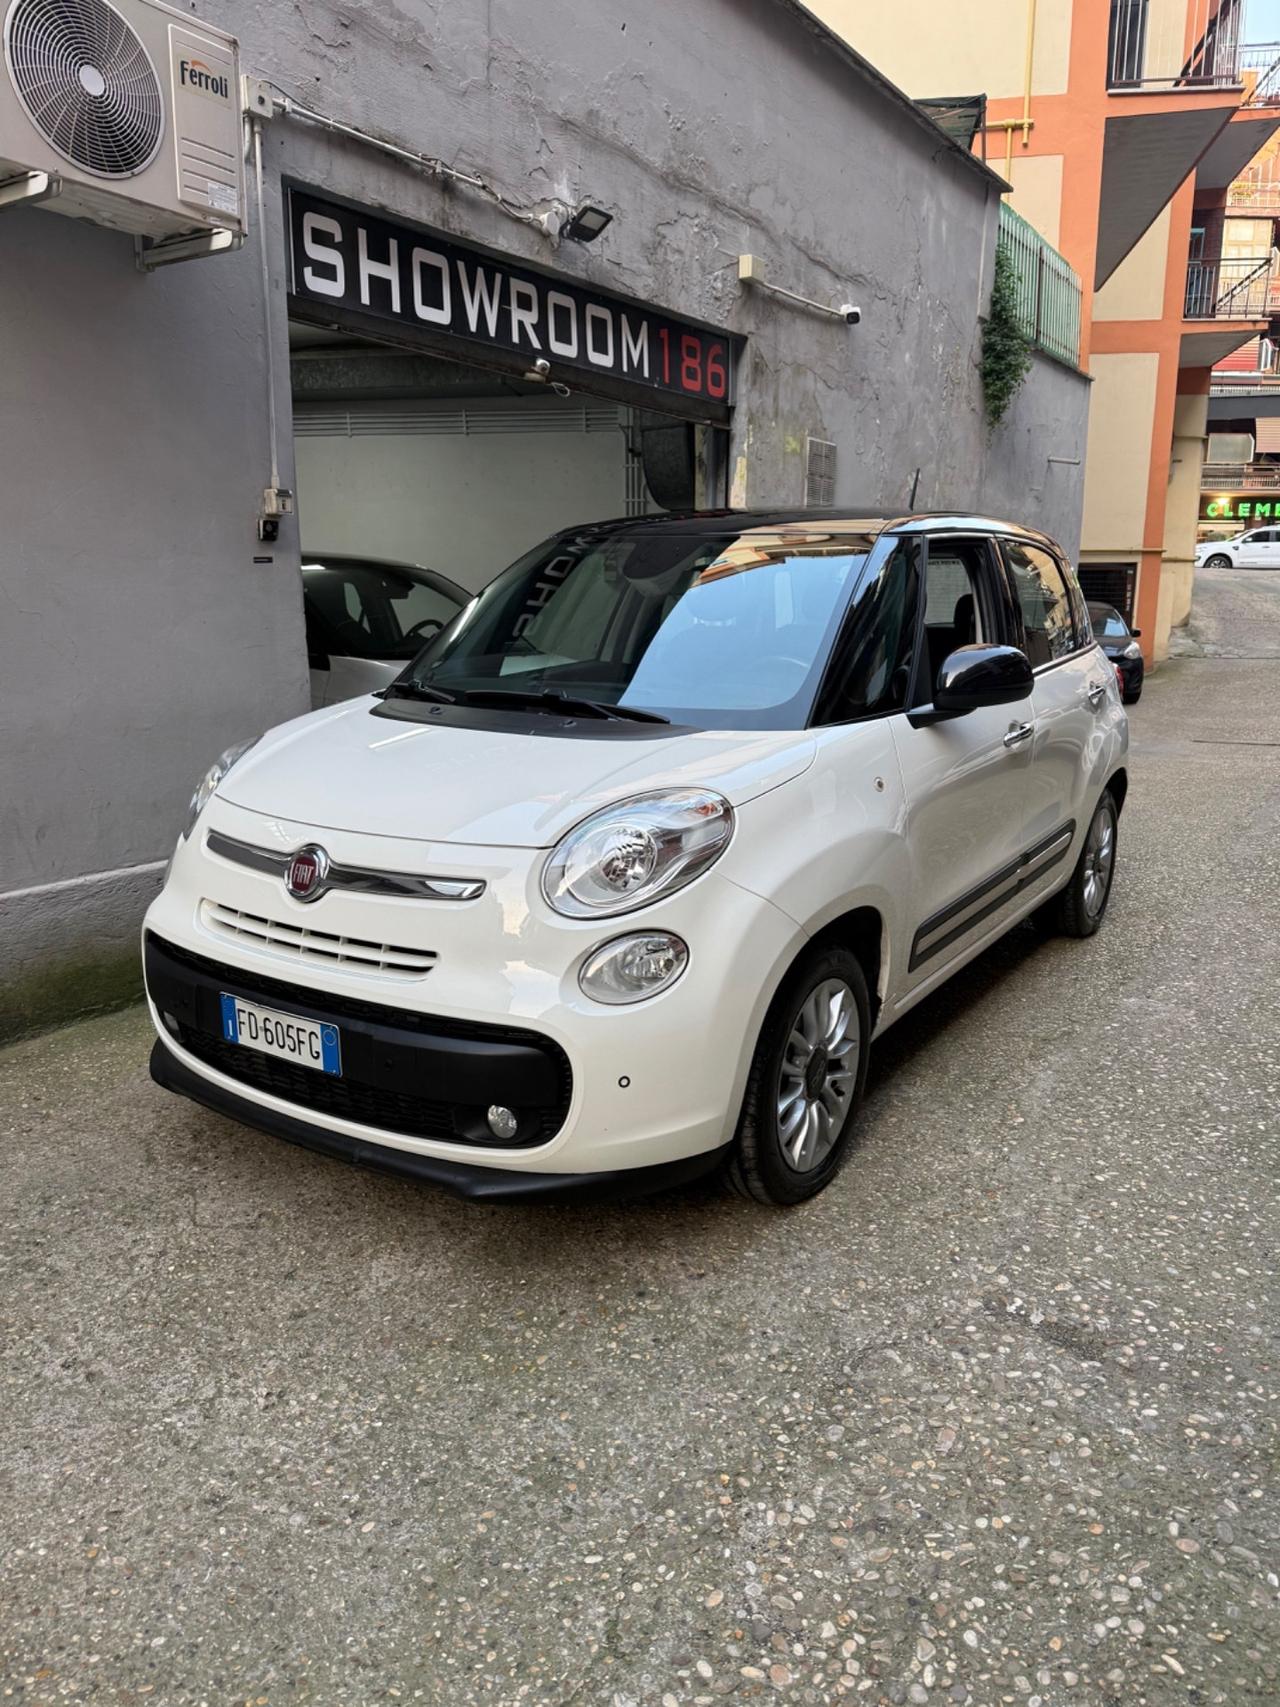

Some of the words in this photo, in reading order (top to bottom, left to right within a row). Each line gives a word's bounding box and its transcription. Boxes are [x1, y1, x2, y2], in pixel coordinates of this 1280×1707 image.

[180, 60, 229, 99] Ferroli
[303, 211, 649, 378] SHOWROOM
[659, 328, 726, 398] 186
[292, 863, 315, 885] FIAT
